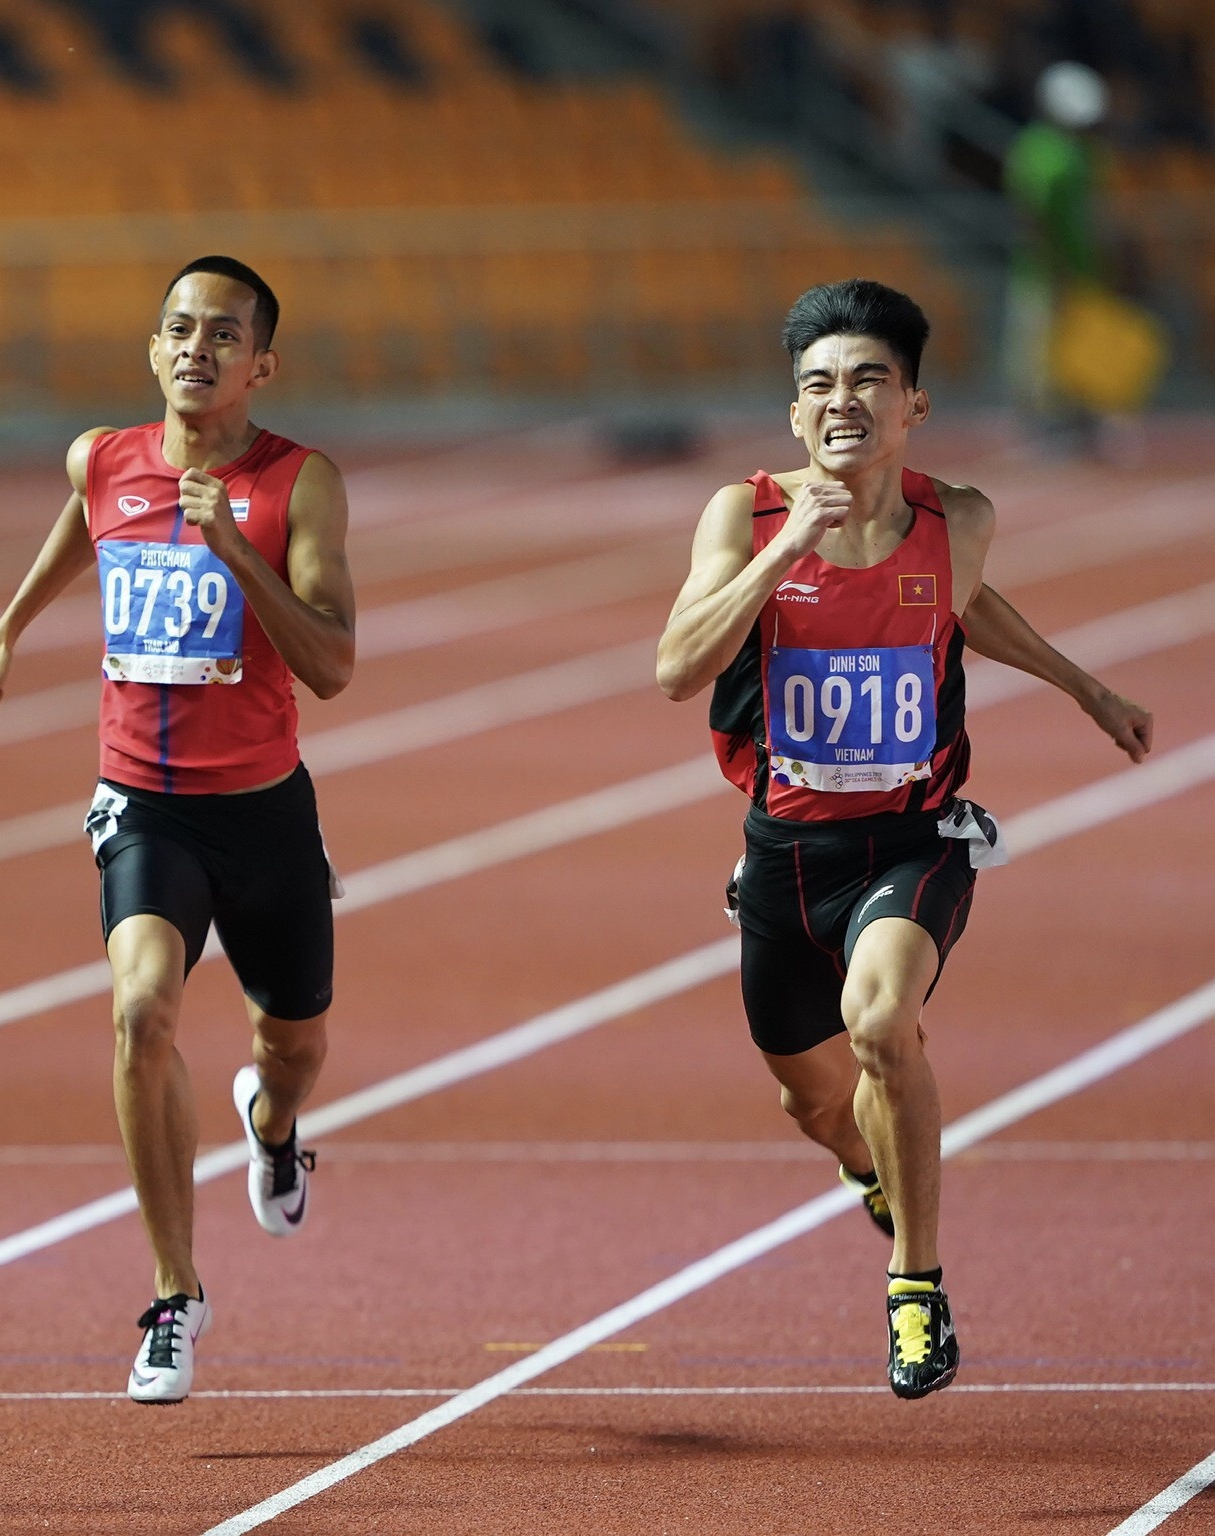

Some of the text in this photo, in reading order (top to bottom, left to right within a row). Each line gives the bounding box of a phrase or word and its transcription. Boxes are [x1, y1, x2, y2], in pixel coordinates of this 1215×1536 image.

[105, 567, 228, 639] 0739
[776, 593, 820, 604] LI-NING
[829, 655, 880, 673] DINH SON
[784, 672, 923, 744] 0918
[835, 748, 874, 762] VIETNAM
